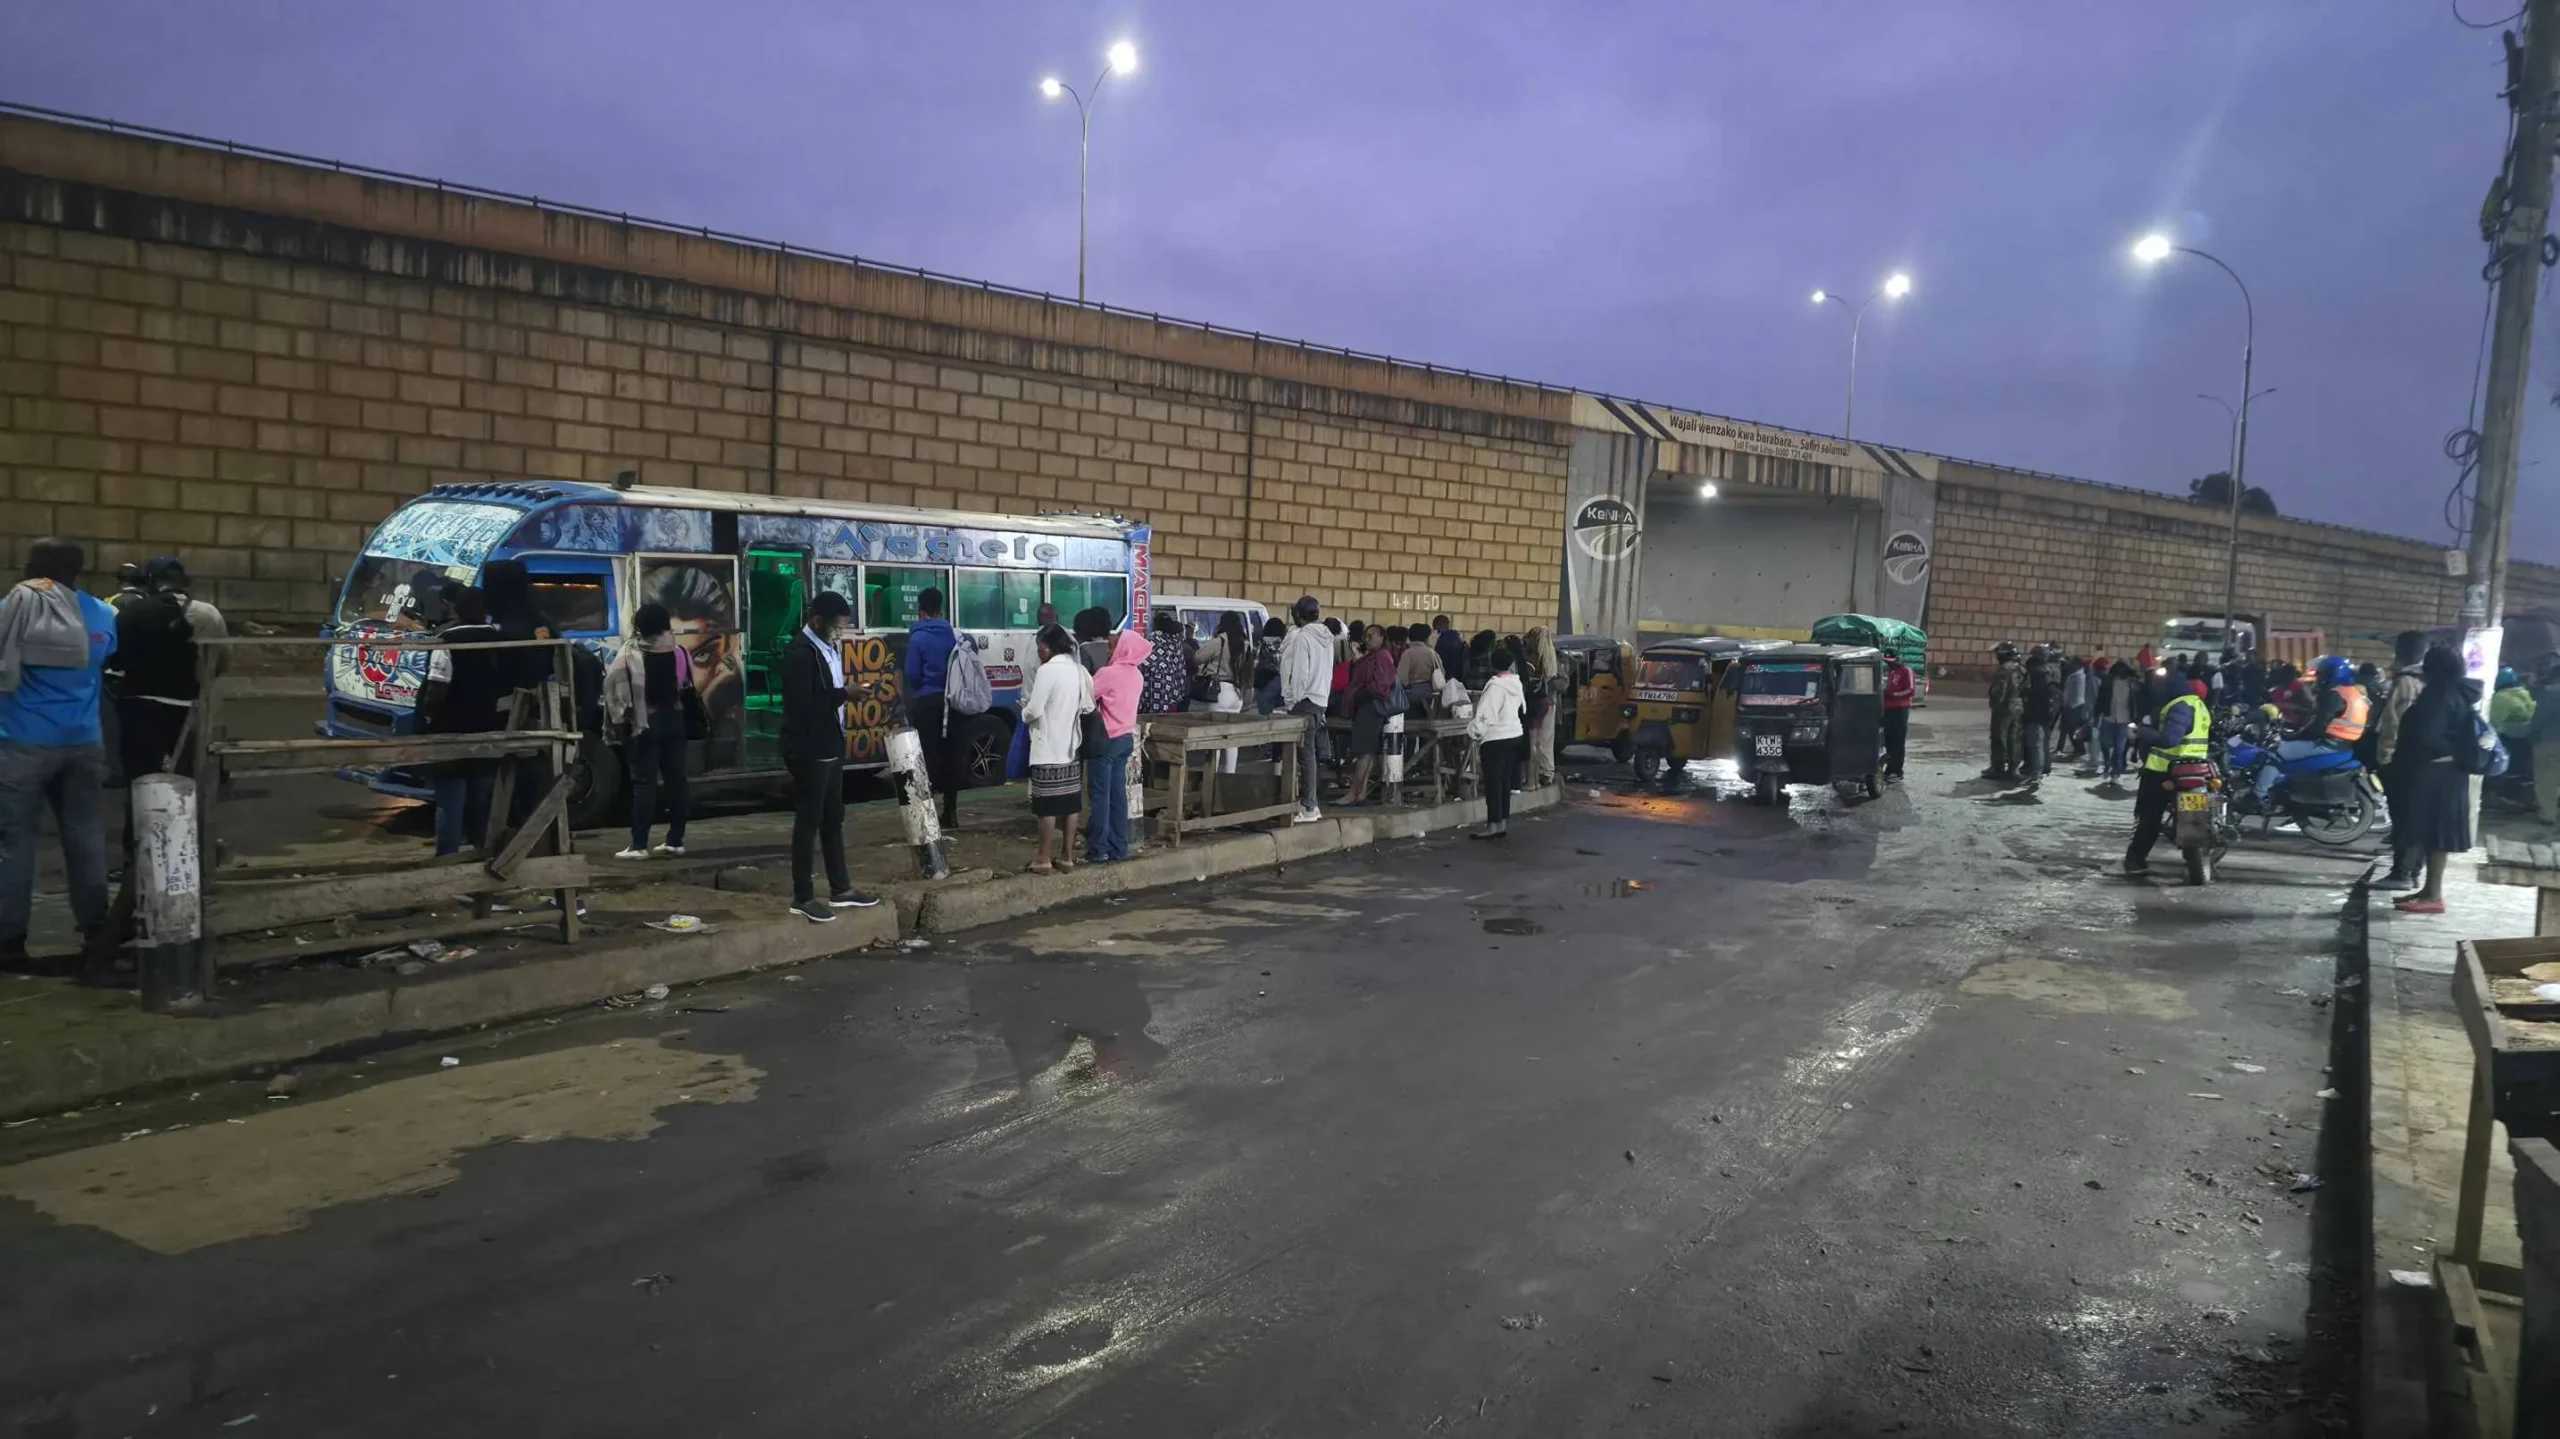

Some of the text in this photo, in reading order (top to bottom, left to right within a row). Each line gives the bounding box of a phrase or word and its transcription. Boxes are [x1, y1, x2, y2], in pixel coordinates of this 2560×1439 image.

[1669, 415, 1697, 432] Wajali
[1699, 422, 1737, 438] wenzako
[1738, 426, 1755, 442] kwa
[1587, 507, 1633, 523] KeNHA
[1892, 540, 1923, 553] KeNHA
[1133, 542, 1149, 638] MACH
[843, 638, 886, 672] NO
[846, 699, 882, 728] NO
